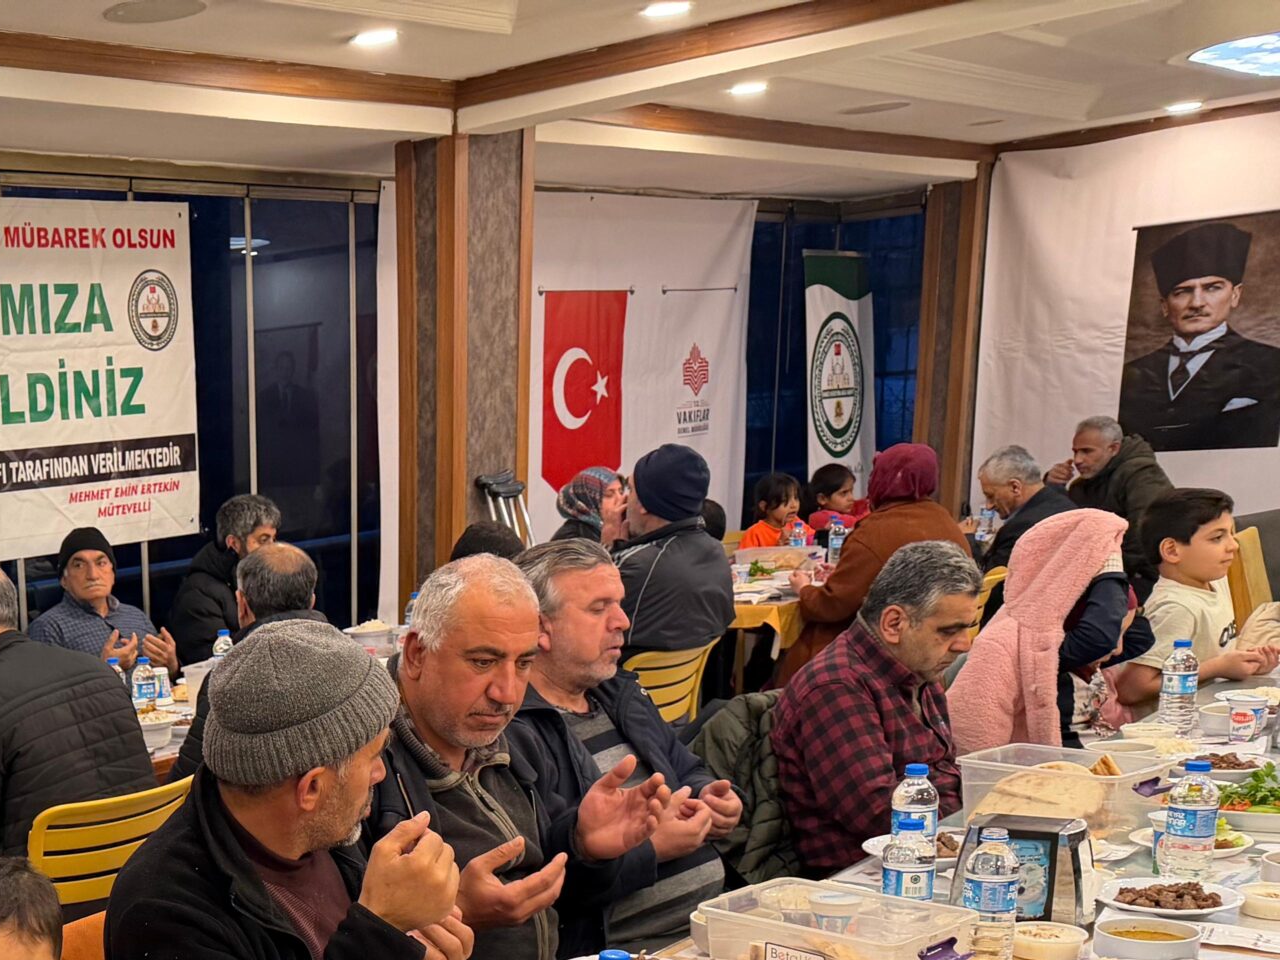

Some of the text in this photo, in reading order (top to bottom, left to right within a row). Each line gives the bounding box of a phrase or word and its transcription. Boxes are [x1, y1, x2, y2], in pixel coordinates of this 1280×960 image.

[4, 222, 106, 249] MÜBAREK
[112, 228, 176, 249] OLSUN
[9, 454, 90, 483] TARAFINDAN
[92, 441, 182, 474] VERİLMEKTEDİR
[69, 477, 181, 504] MEHMET EMİN ERTEKİN
[97, 497, 152, 519] MÜTEVELLİ
